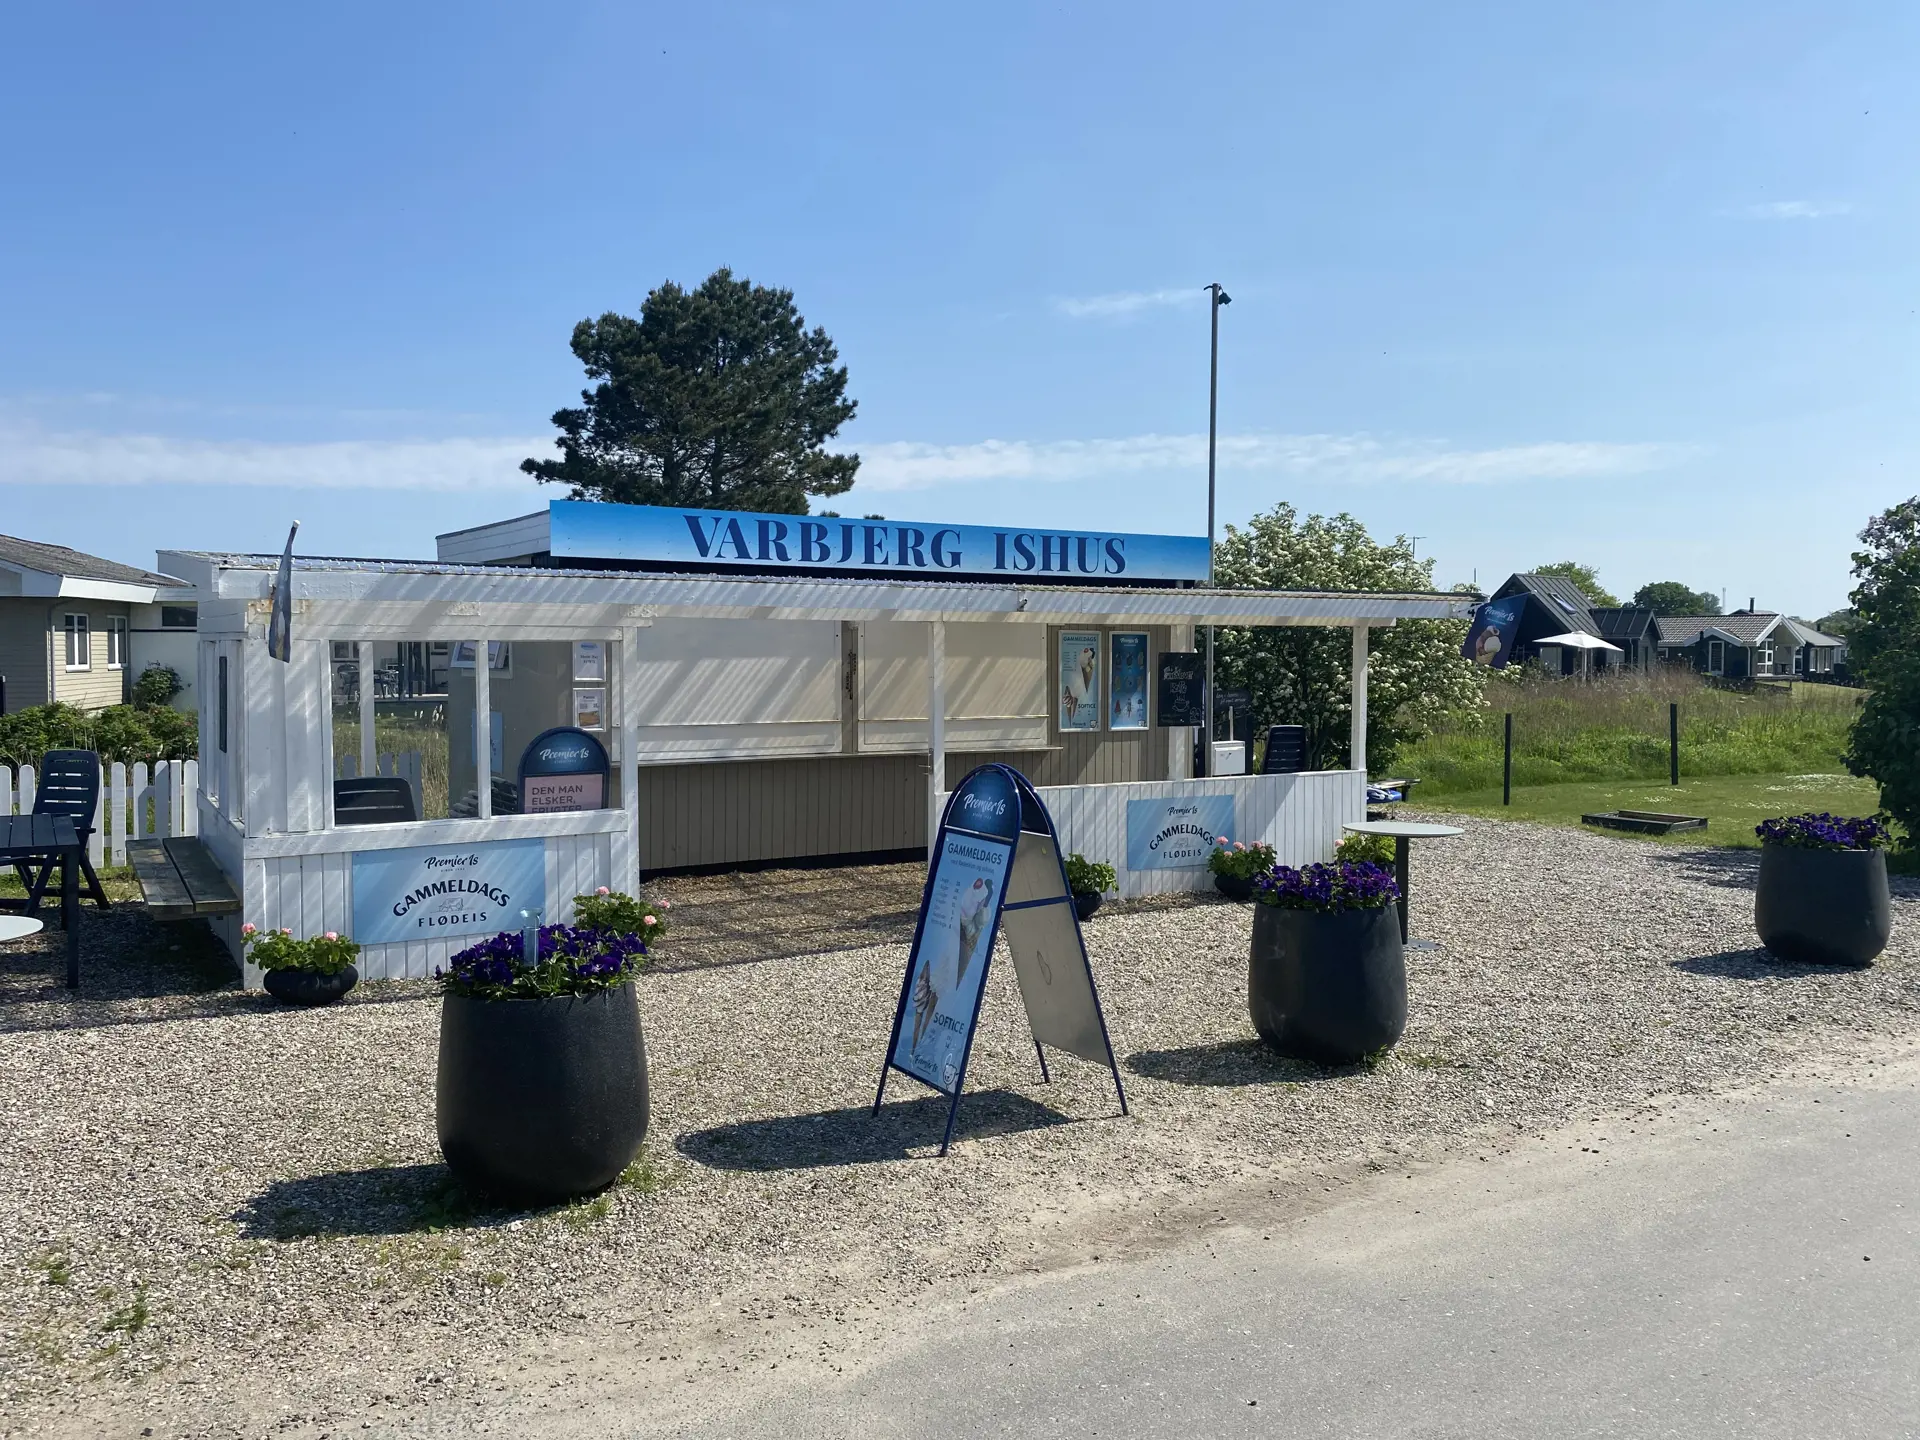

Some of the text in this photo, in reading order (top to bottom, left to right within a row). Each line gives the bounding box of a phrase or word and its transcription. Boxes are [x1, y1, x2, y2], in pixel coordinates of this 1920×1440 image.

[682, 515, 1126, 575] VARBJERG ISHUS
[540, 747, 590, 761] Premier Is
[531, 784, 583, 796] DEN MAN
[531, 795, 576, 806] ELSKER,
[963, 793, 1006, 815] Premier Is
[1167, 806, 1192, 816] Premier
[1149, 823, 1215, 851] GAMMELDAGS
[424, 853, 479, 869] Premier Is
[947, 842, 1003, 865] GAMMELDAGS
[1163, 848, 1202, 859] FLØDEIS
[392, 879, 511, 917] GAMMELDAGS
[418, 911, 487, 927] FLØDEIS
[933, 1012, 965, 1035] SOFTICE
